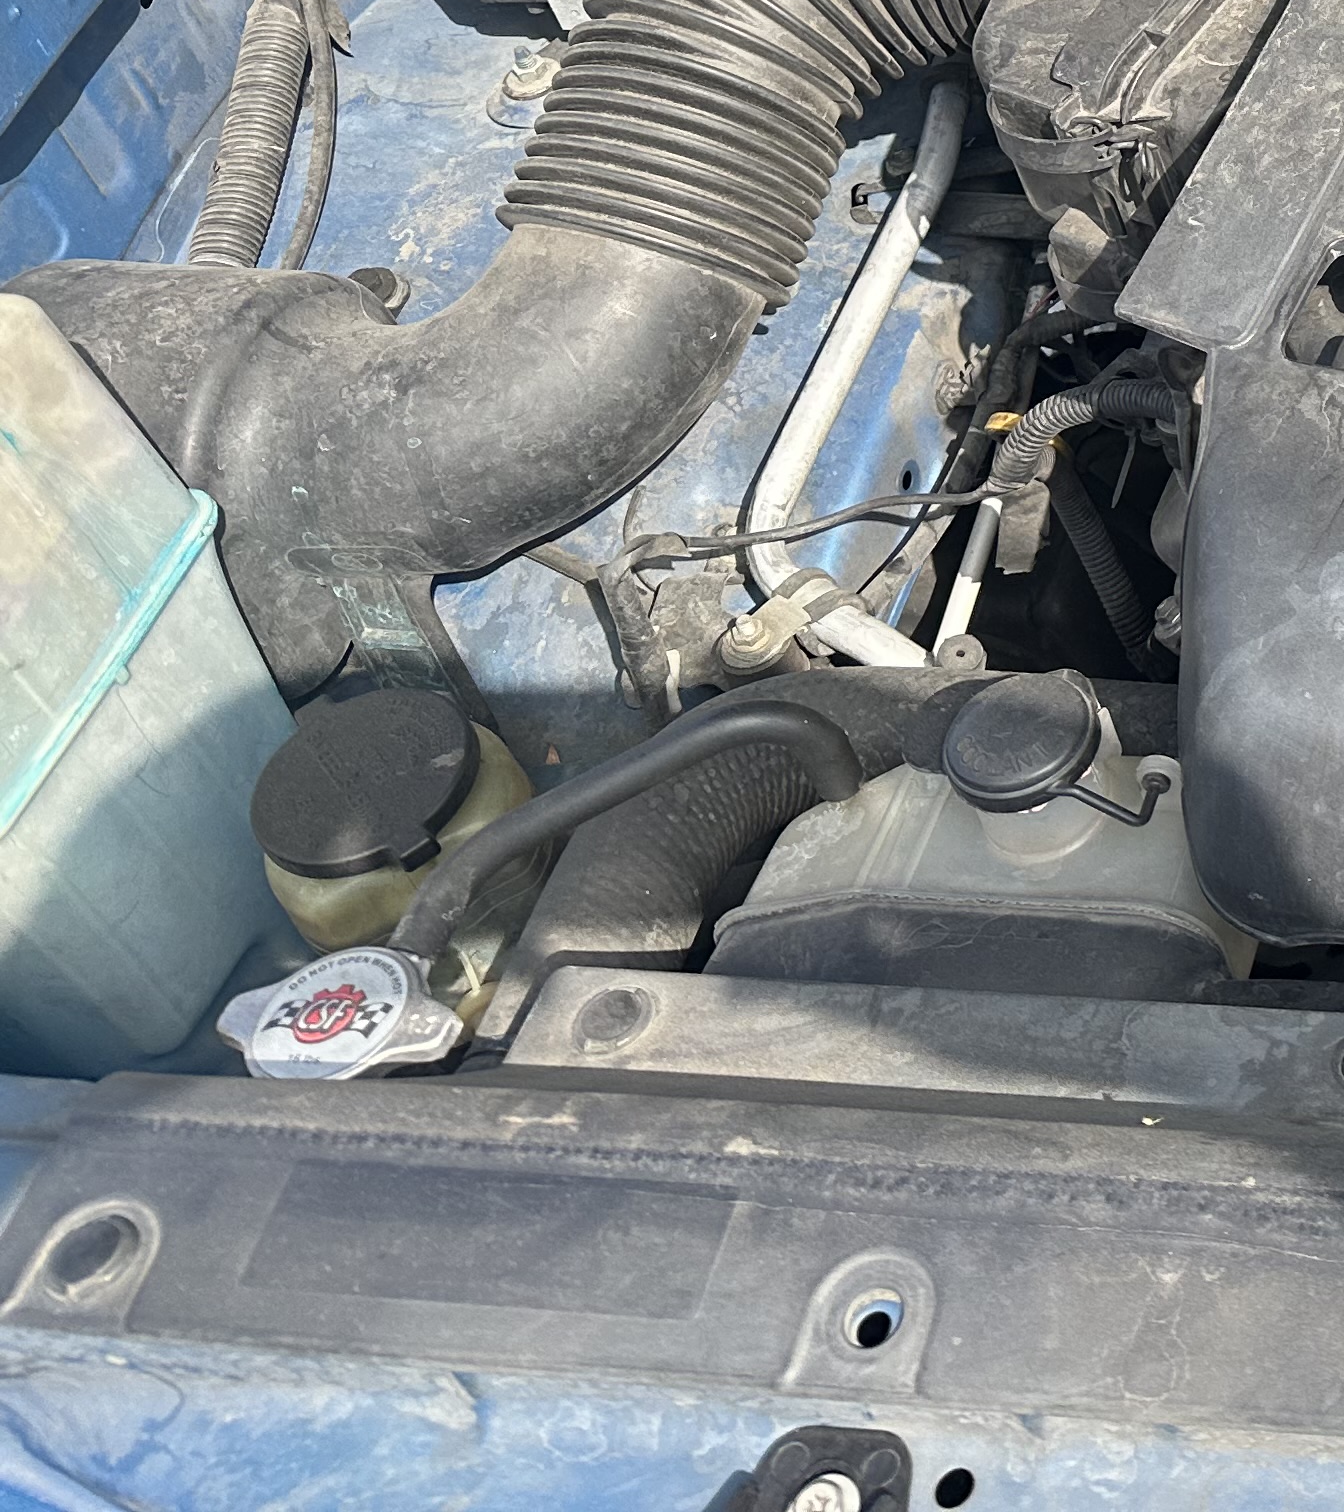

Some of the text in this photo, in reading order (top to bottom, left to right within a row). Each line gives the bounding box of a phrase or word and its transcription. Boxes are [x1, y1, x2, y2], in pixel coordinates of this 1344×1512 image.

[289, 977, 307, 990] DO
[308, 961, 335, 978] NOT
[338, 956, 371, 965] OPEN
[371, 957, 397, 979] WHEN
[297, 998, 348, 1030] CSF
